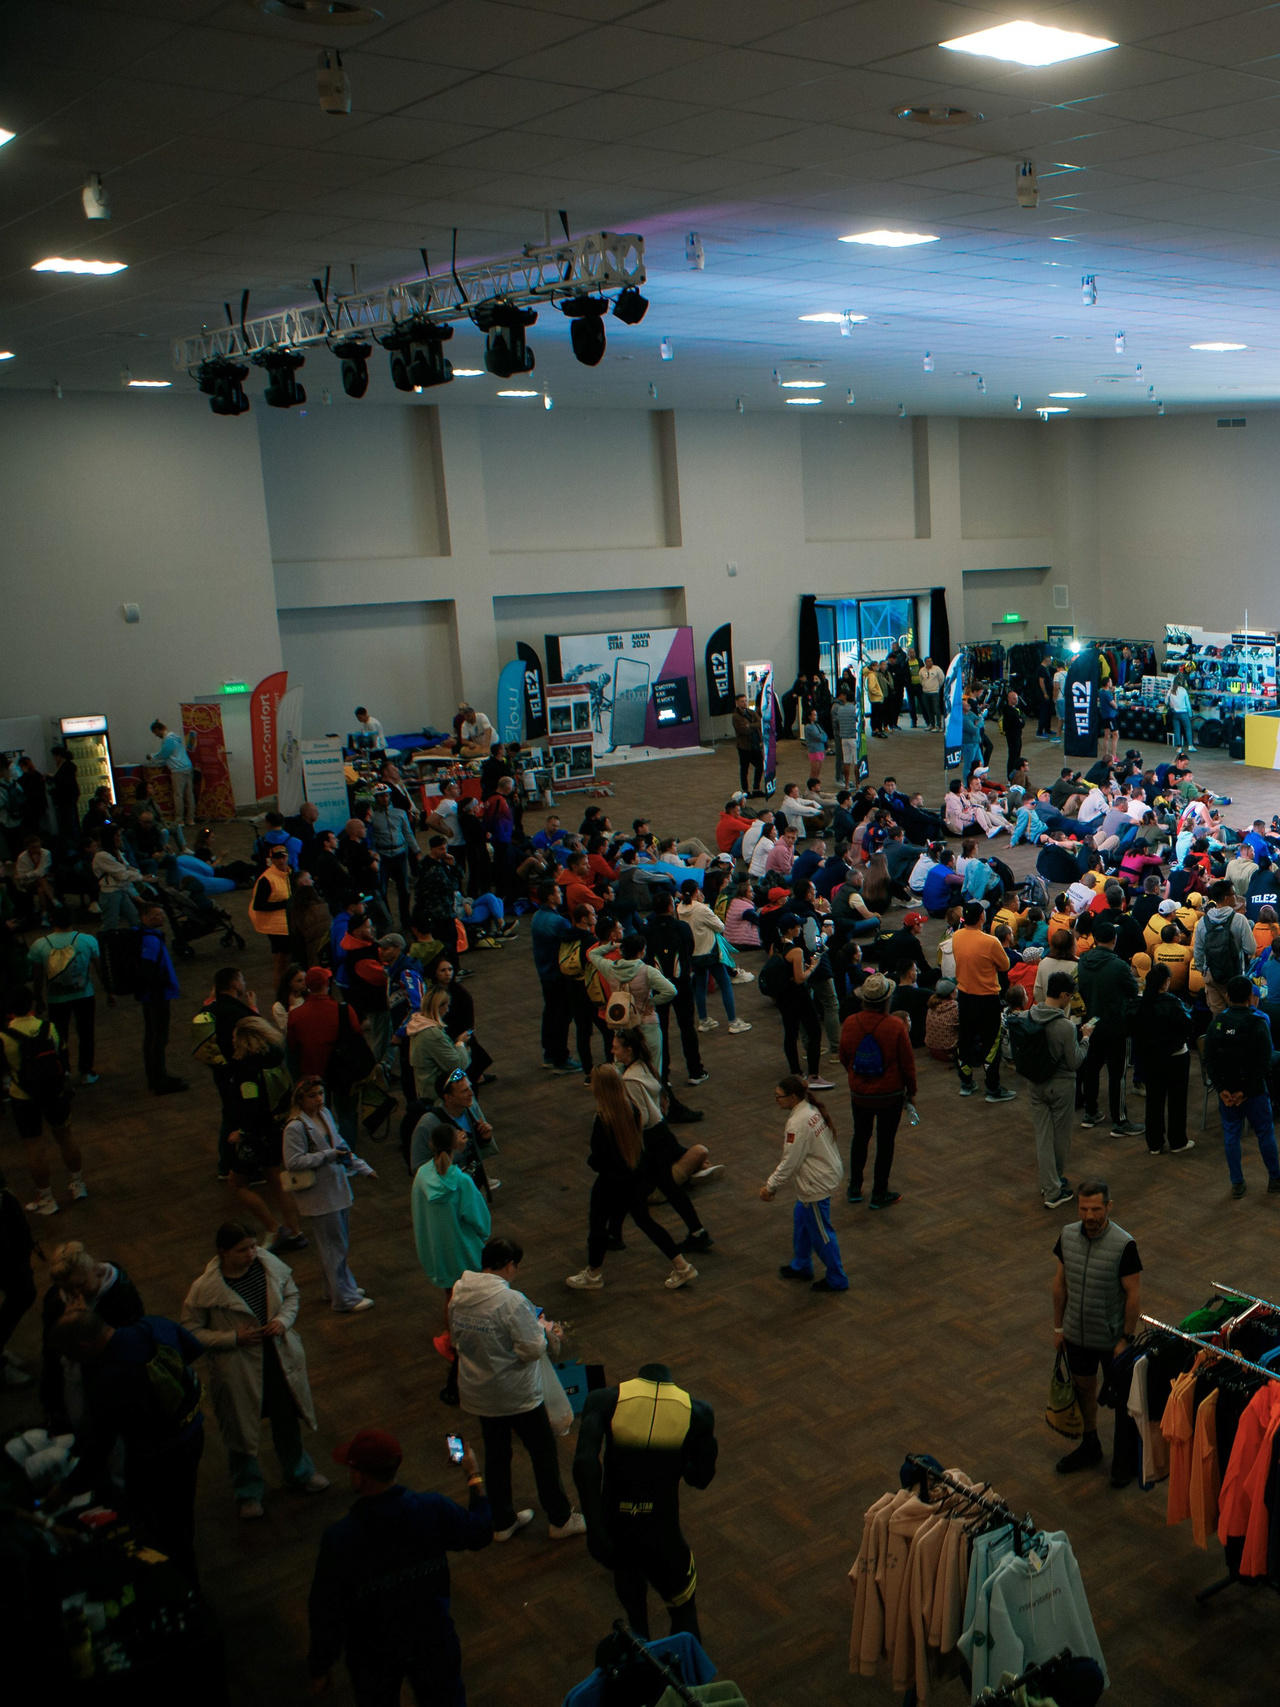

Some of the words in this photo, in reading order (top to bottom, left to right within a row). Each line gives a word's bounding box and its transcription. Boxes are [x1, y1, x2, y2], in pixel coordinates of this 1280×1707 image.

[608, 642, 624, 650] STAR
[631, 640, 650, 649] 2023
[525, 668, 542, 720] TELE2
[711, 650, 729, 699] TELE2
[1071, 680, 1092, 737] TELE2
[1251, 893, 1278, 905] TELE2
